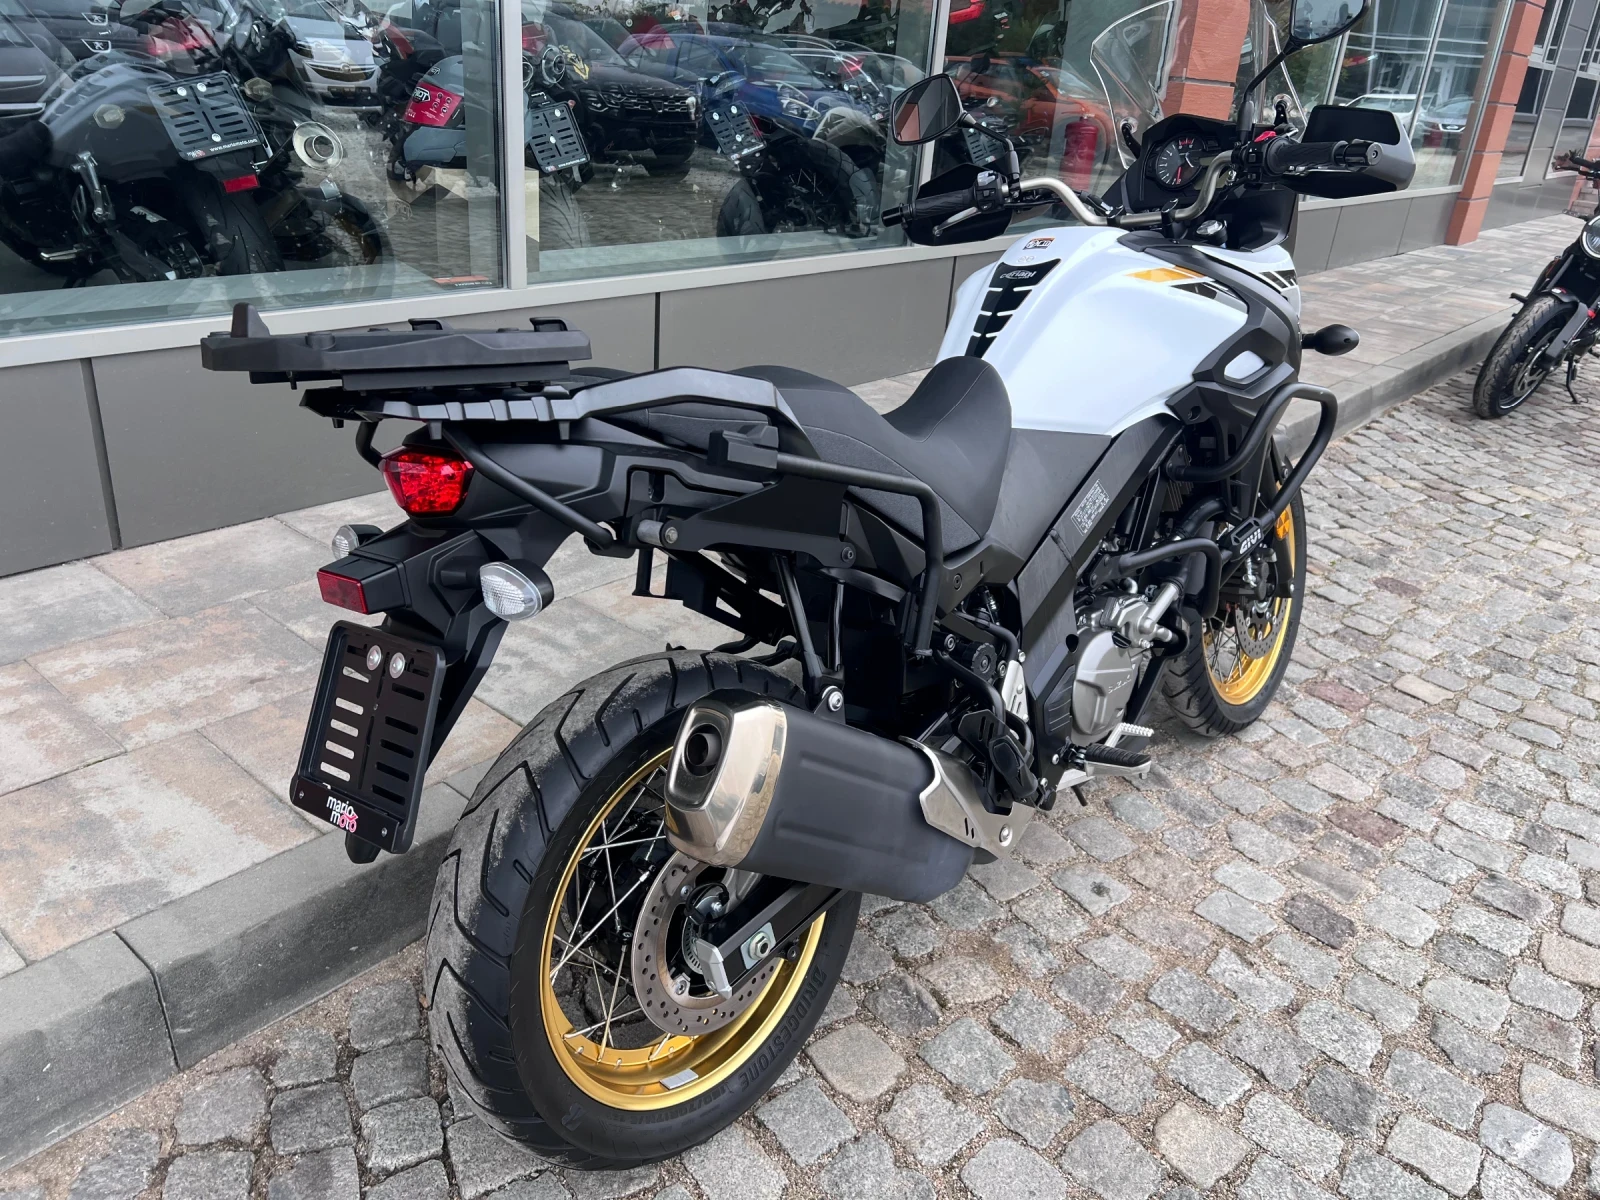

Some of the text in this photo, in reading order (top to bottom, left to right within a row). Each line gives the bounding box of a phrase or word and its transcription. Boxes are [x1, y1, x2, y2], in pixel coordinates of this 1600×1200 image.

[1240, 528, 1261, 554] GIVI
[326, 796, 355, 816] mario
[330, 811, 357, 833] moto
[739, 965, 828, 1092] BRIDGESTONE
